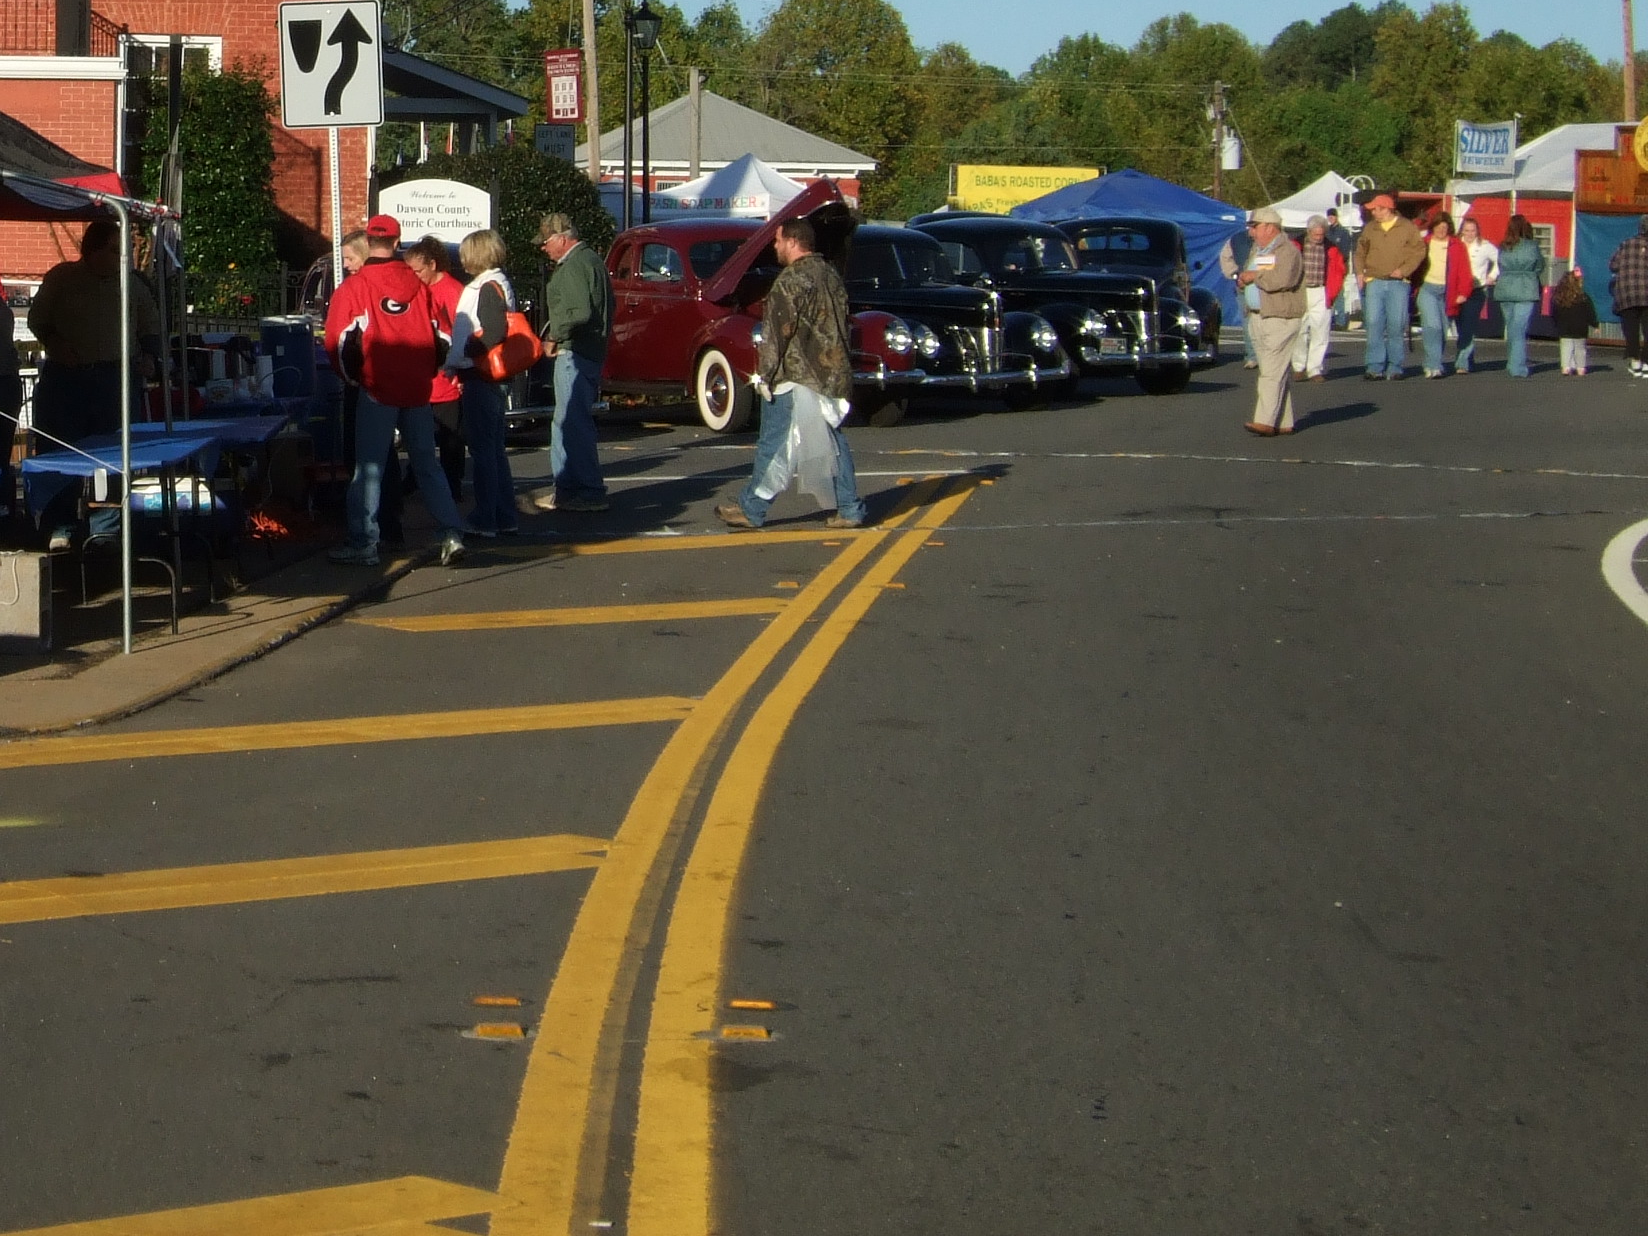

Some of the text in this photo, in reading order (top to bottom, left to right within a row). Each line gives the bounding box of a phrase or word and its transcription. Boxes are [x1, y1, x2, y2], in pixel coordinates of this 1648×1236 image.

[1460, 127, 1510, 155] SILVER
[975, 175, 1006, 187] BABA'S
[1009, 175, 1051, 188] ROASTED
[396, 203, 472, 217] Dawson County
[714, 196, 757, 210] MAKER
[399, 217, 483, 229] toric Courthouse
